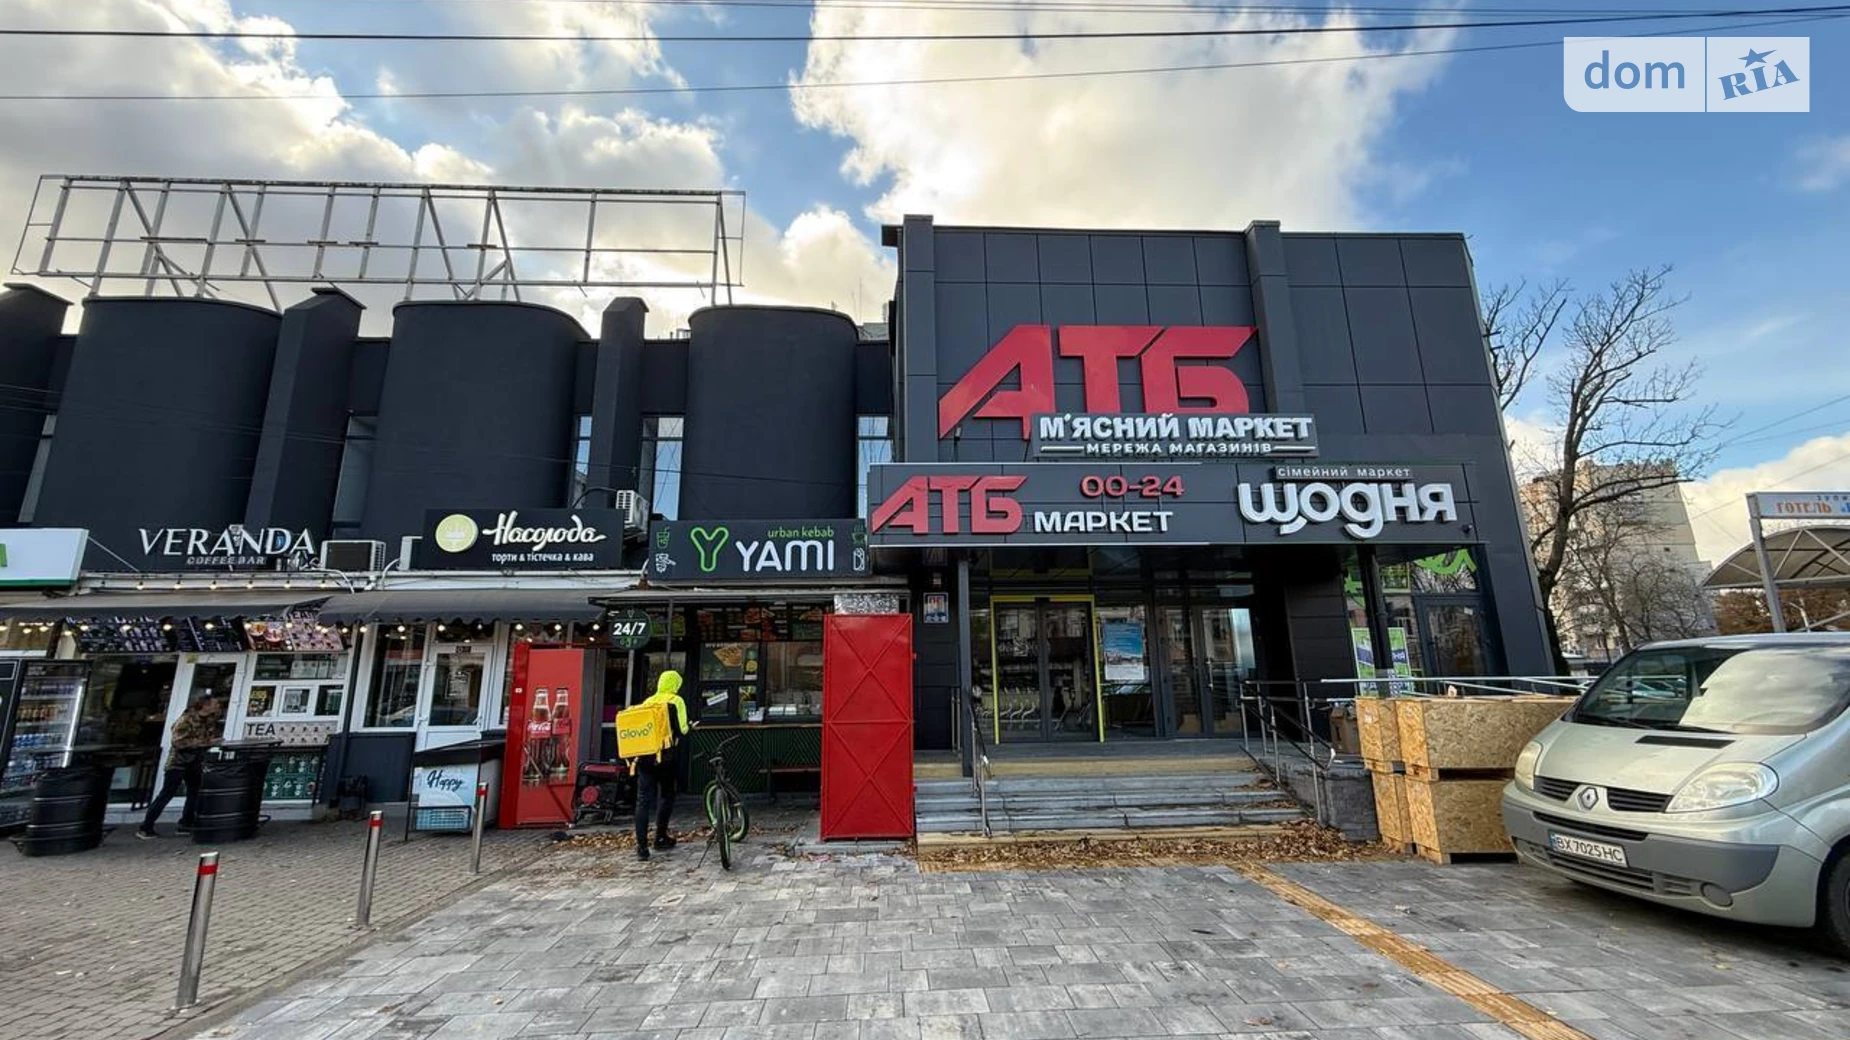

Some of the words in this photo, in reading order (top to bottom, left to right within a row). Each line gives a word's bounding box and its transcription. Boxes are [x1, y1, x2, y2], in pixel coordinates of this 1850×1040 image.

[938, 324, 1258, 440] АТБ
[1040, 413, 1181, 439] М'ЯСНИЙ
[1189, 417, 1313, 438] МАРКЕТ
[1086, 443, 1162, 454] МЕРЕЖА
[1169, 443, 1272, 454] МАГАЗИНІВ
[1278, 465, 1349, 478] сімейний
[1357, 467, 1411, 479] маркет
[1081, 475, 1185, 498] 00-24
[872, 475, 1029, 534] АТБ
[482, 510, 607, 552] Насолода
[767, 527, 799, 538] urban
[802, 526, 834, 538] kebab
[1034, 511, 1173, 533] МАРКЕТ
[138, 527, 315, 556] VERANDA
[186, 556, 236, 565] COFFEE
[238, 556, 266, 565] BAR
[492, 553, 517, 564] торти
[519, 554, 525, 562] &
[527, 552, 562, 562] тістечка
[565, 554, 570, 562] &
[573, 554, 594, 562] кава
[735, 540, 834, 572] YAMI
[612, 621, 646, 636] 24/7
[246, 723, 275, 736] TEA
[619, 725, 651, 740] Glovo
[427, 769, 464, 792] Happy
